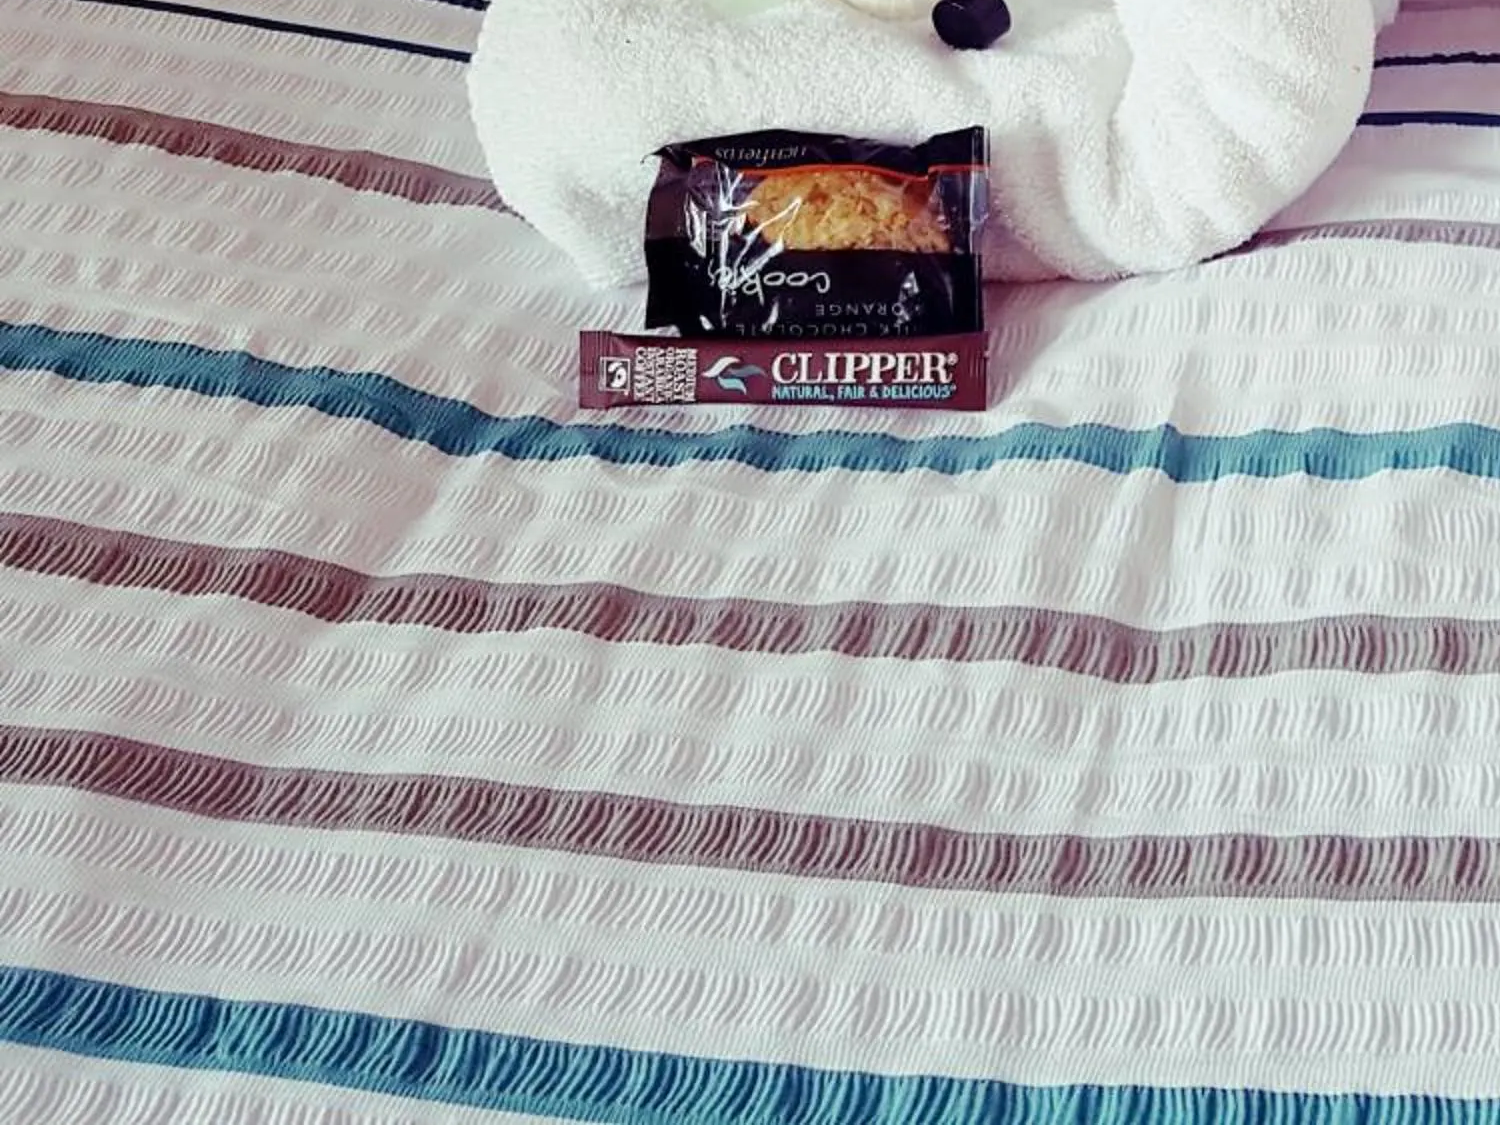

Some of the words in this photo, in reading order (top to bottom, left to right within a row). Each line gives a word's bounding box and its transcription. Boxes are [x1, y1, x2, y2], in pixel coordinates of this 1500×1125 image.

[815, 303, 908, 317] ORANGE
[674, 347, 687, 401] ROAST
[771, 384, 835, 402] NATURAL,
[837, 385, 865, 399] FAIR
[869, 386, 879, 399] &
[882, 384, 951, 399] DELICIOUS
